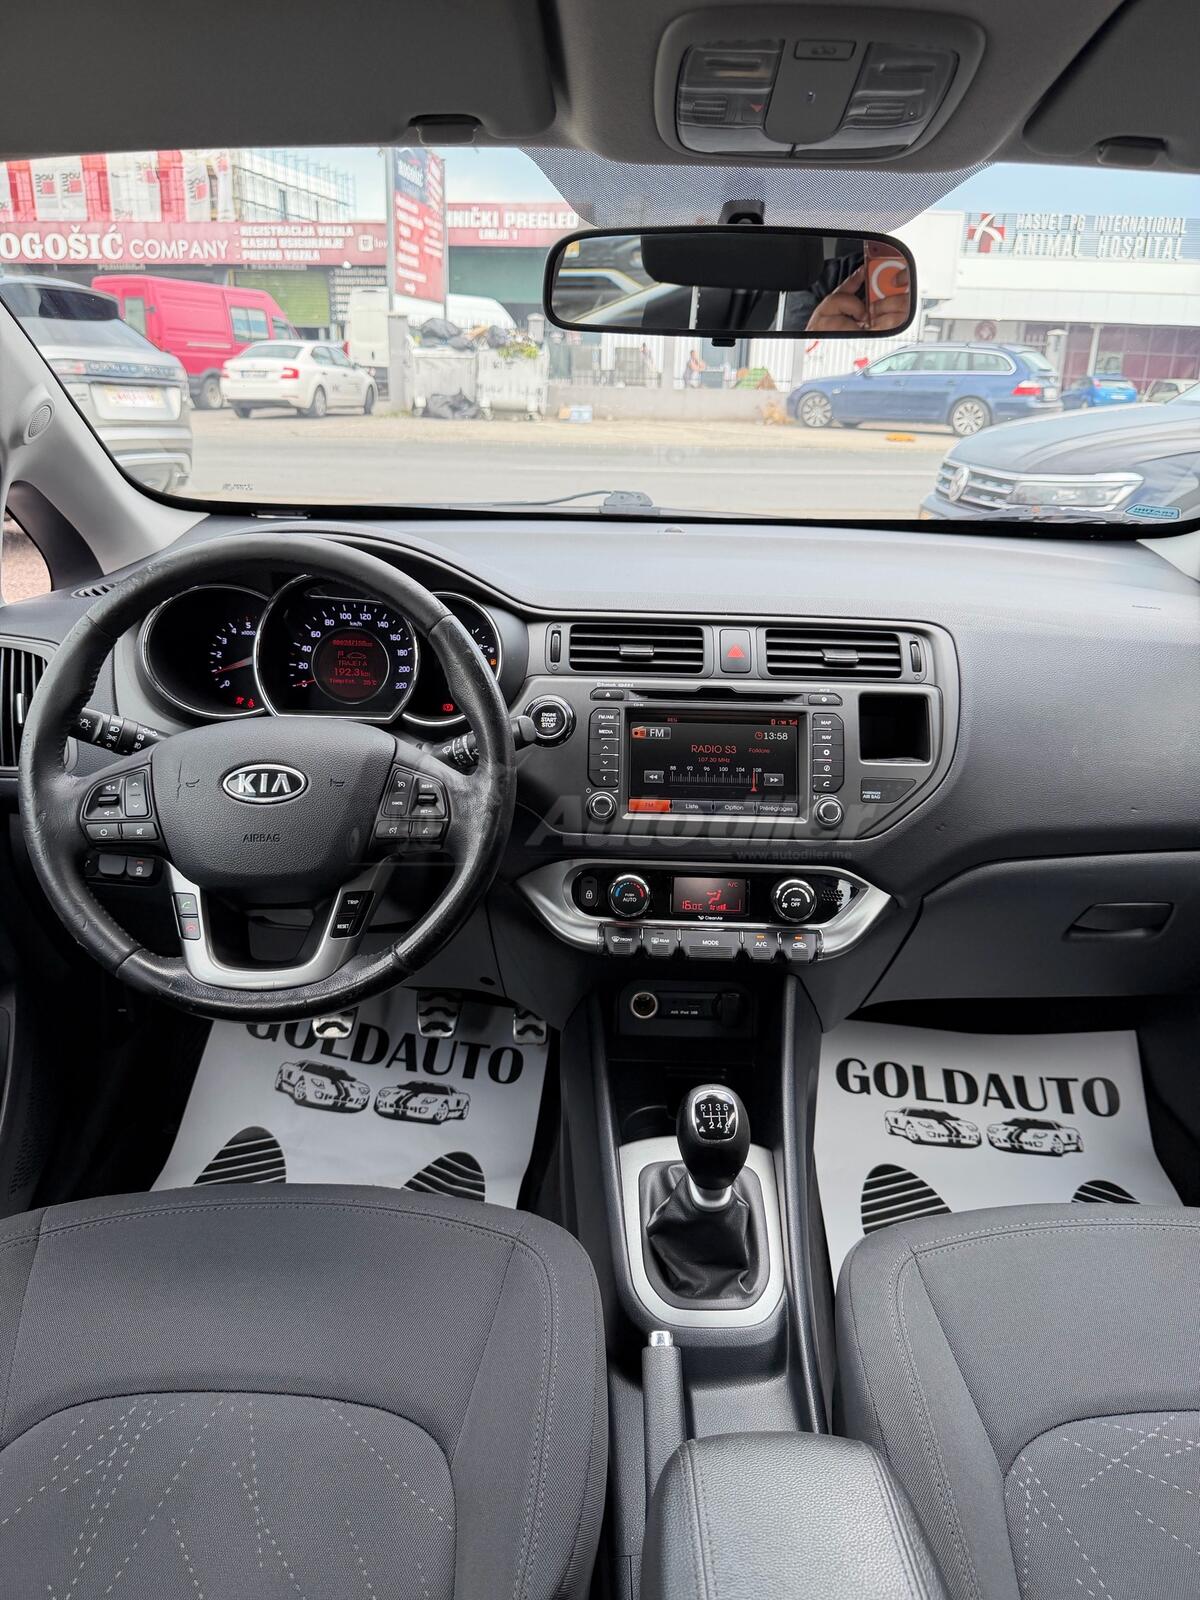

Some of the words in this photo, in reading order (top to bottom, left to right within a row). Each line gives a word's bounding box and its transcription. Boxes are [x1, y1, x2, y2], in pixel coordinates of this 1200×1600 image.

[503, 210, 579, 230] PREGLED
[1093, 215, 1187, 235] INTERNATIONAL
[128, 238, 229, 260] COMPANY
[1011, 233, 1080, 258] ANIMAL
[1096, 234, 1184, 261] HOSPITAL
[339, 612, 351, 620] 100
[359, 613, 372, 621] 120
[377, 621, 389, 629] 140
[389, 633, 401, 641] 160
[298, 662, 309, 670] 20
[649, 728, 664, 738] FM
[763, 732, 788, 740] 13:58
[691, 744, 722, 753] RADIO
[725, 745, 737, 754] S3
[238, 773, 292, 793] KIA
[242, 833, 281, 844] AIRBAG
[727, 880, 738, 888] A/C
[835, 1058, 1121, 1117] GOLDAUTO
